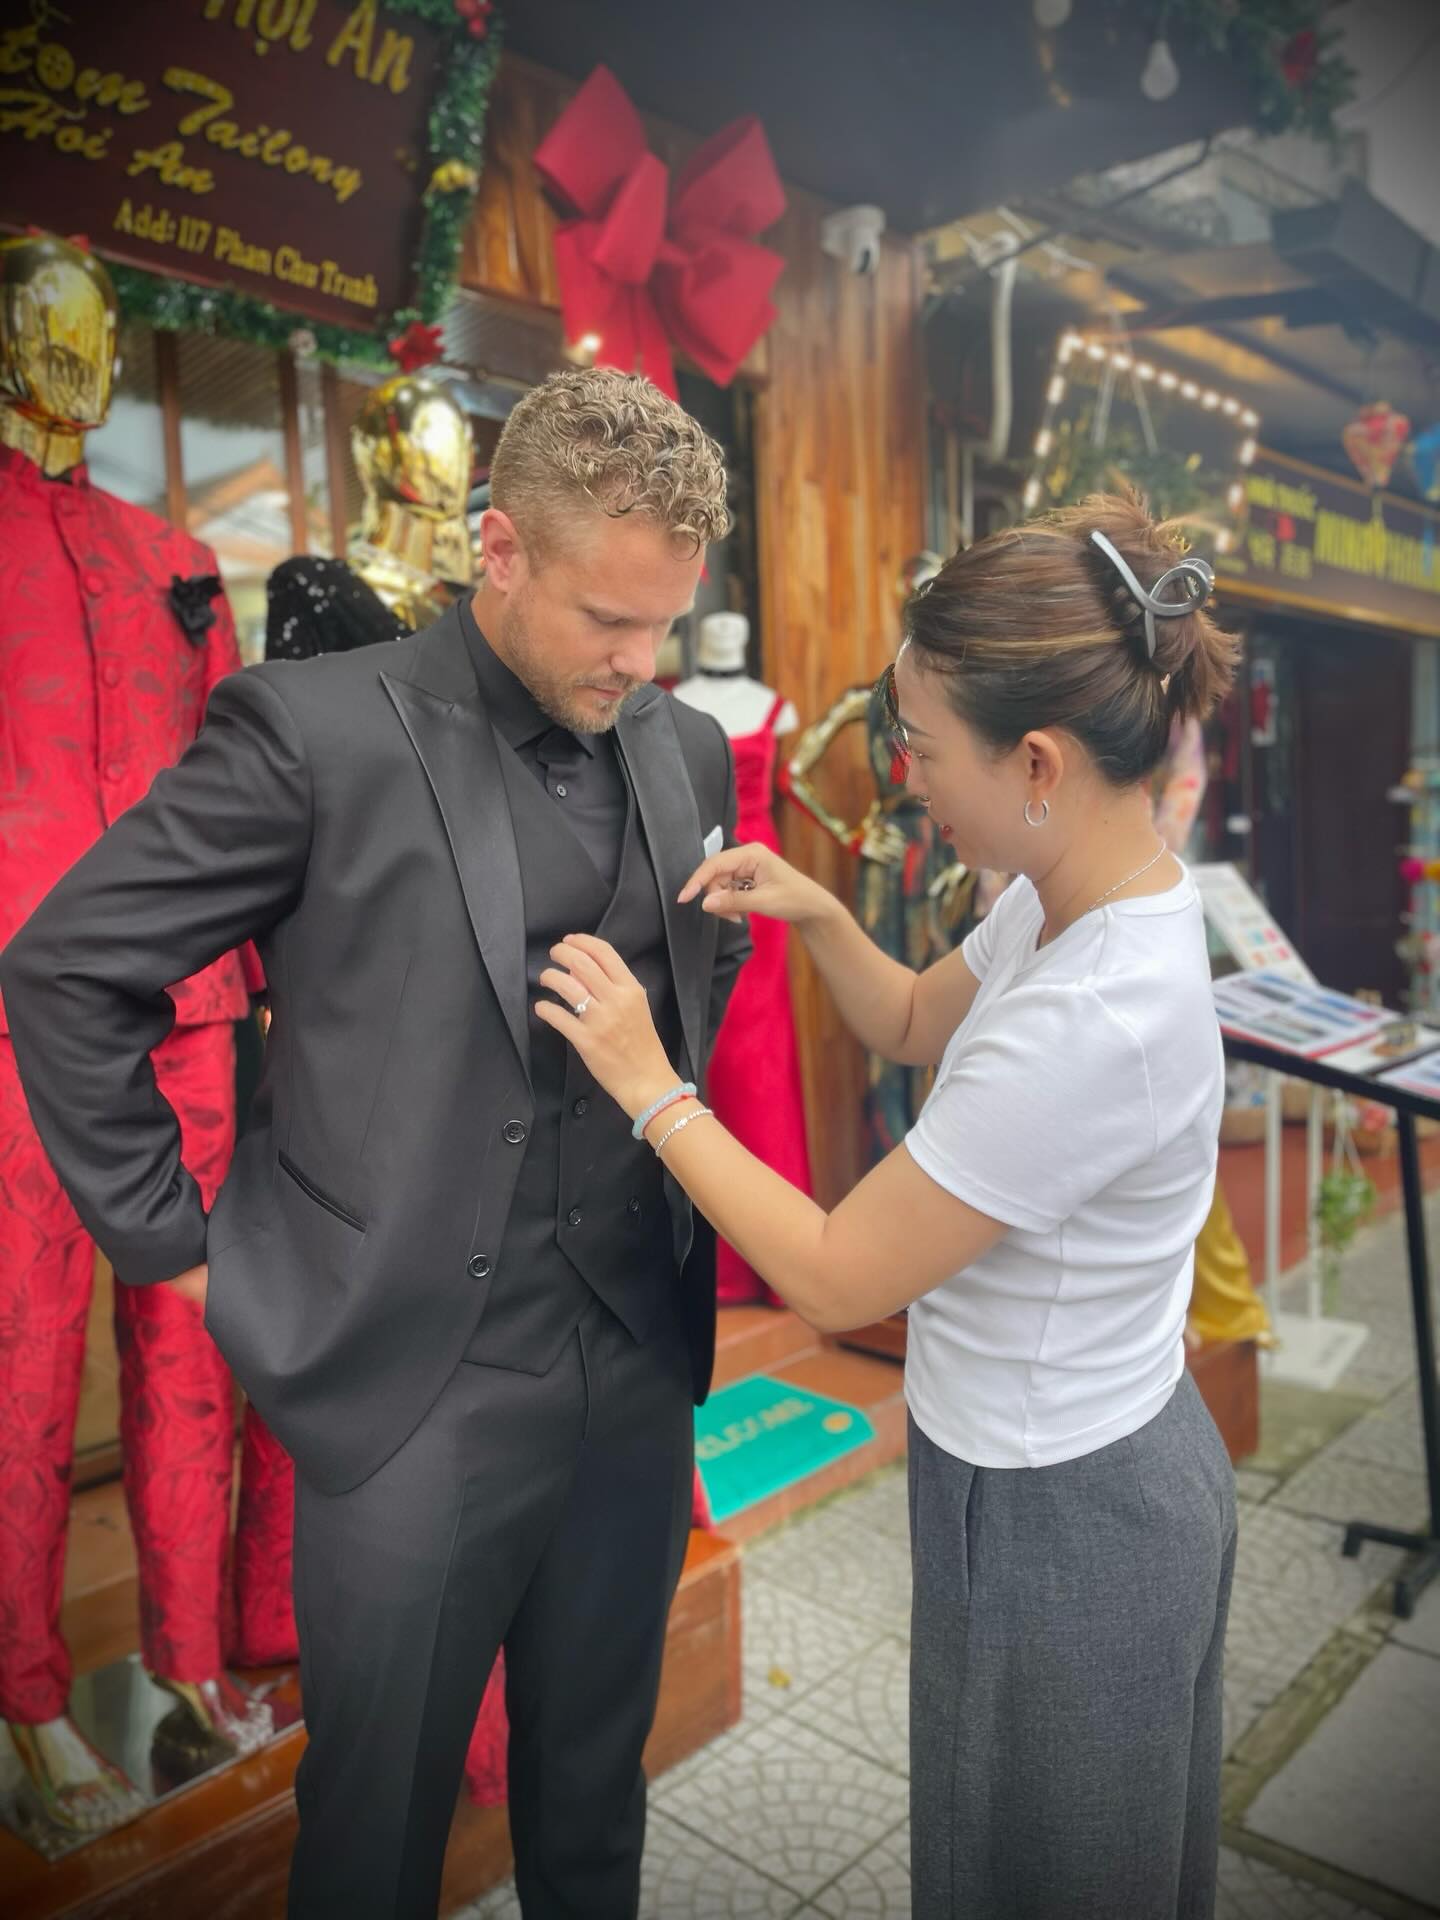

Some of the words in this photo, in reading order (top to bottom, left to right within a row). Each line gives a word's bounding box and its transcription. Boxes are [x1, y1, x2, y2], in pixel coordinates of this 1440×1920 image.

[326, 0, 414, 93] An
[127, 141, 216, 194] An
[112, 198, 176, 243] Add:
[176, 215, 212, 254] 117
[214, 224, 272, 275] Phan
[274, 245, 320, 288] Chu
